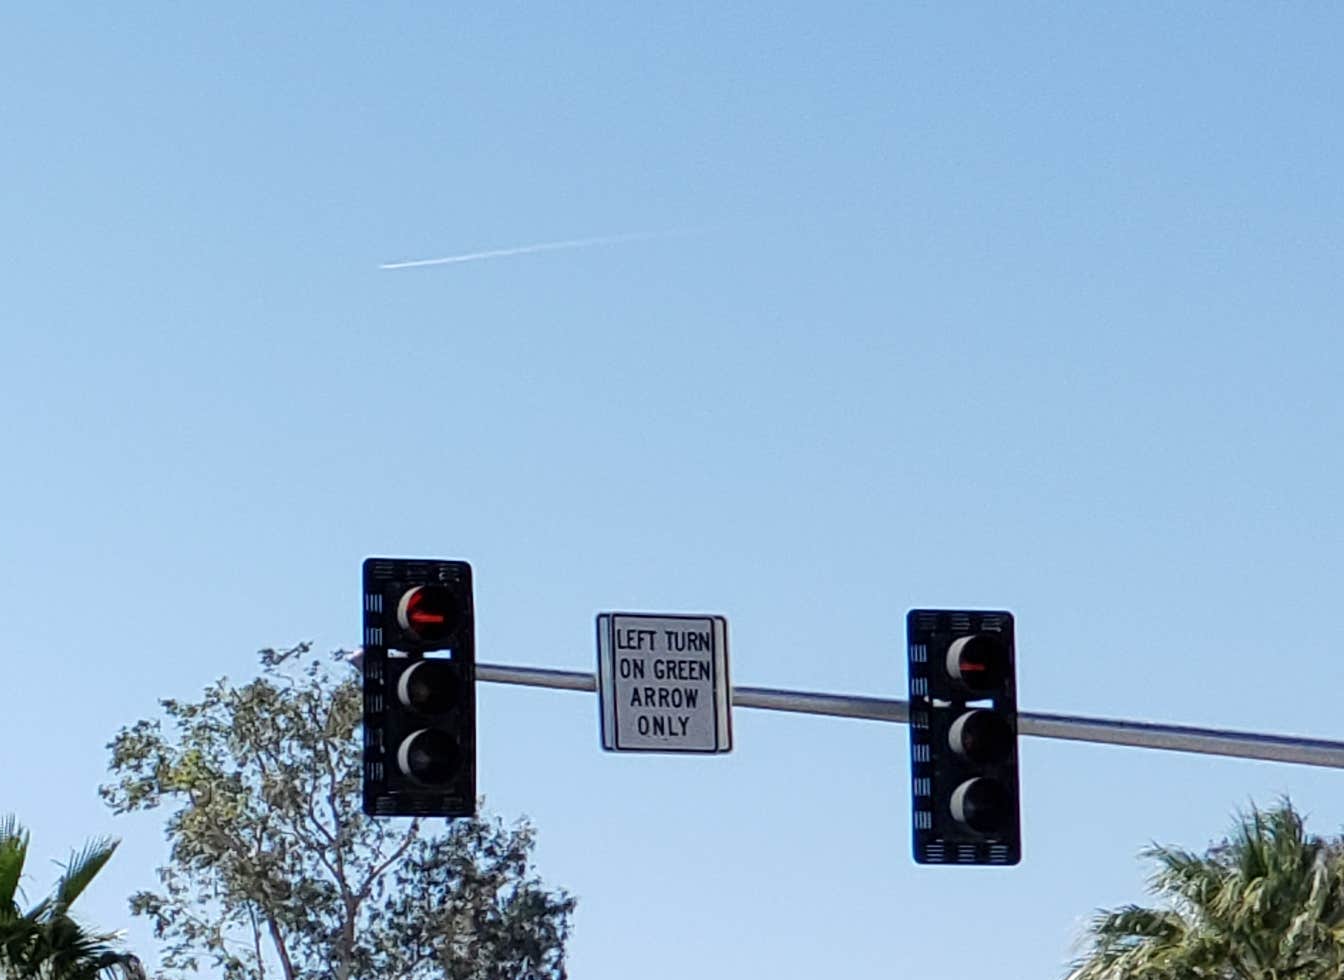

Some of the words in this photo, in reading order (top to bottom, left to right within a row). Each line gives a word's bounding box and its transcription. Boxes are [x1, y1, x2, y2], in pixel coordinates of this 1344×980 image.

[617, 629, 657, 651] LEFT
[665, 631, 710, 651] TURN
[620, 658, 644, 679] ON
[653, 660, 710, 681] GREEN
[630, 687, 699, 708] ARROW
[637, 715, 690, 736] ONLY
